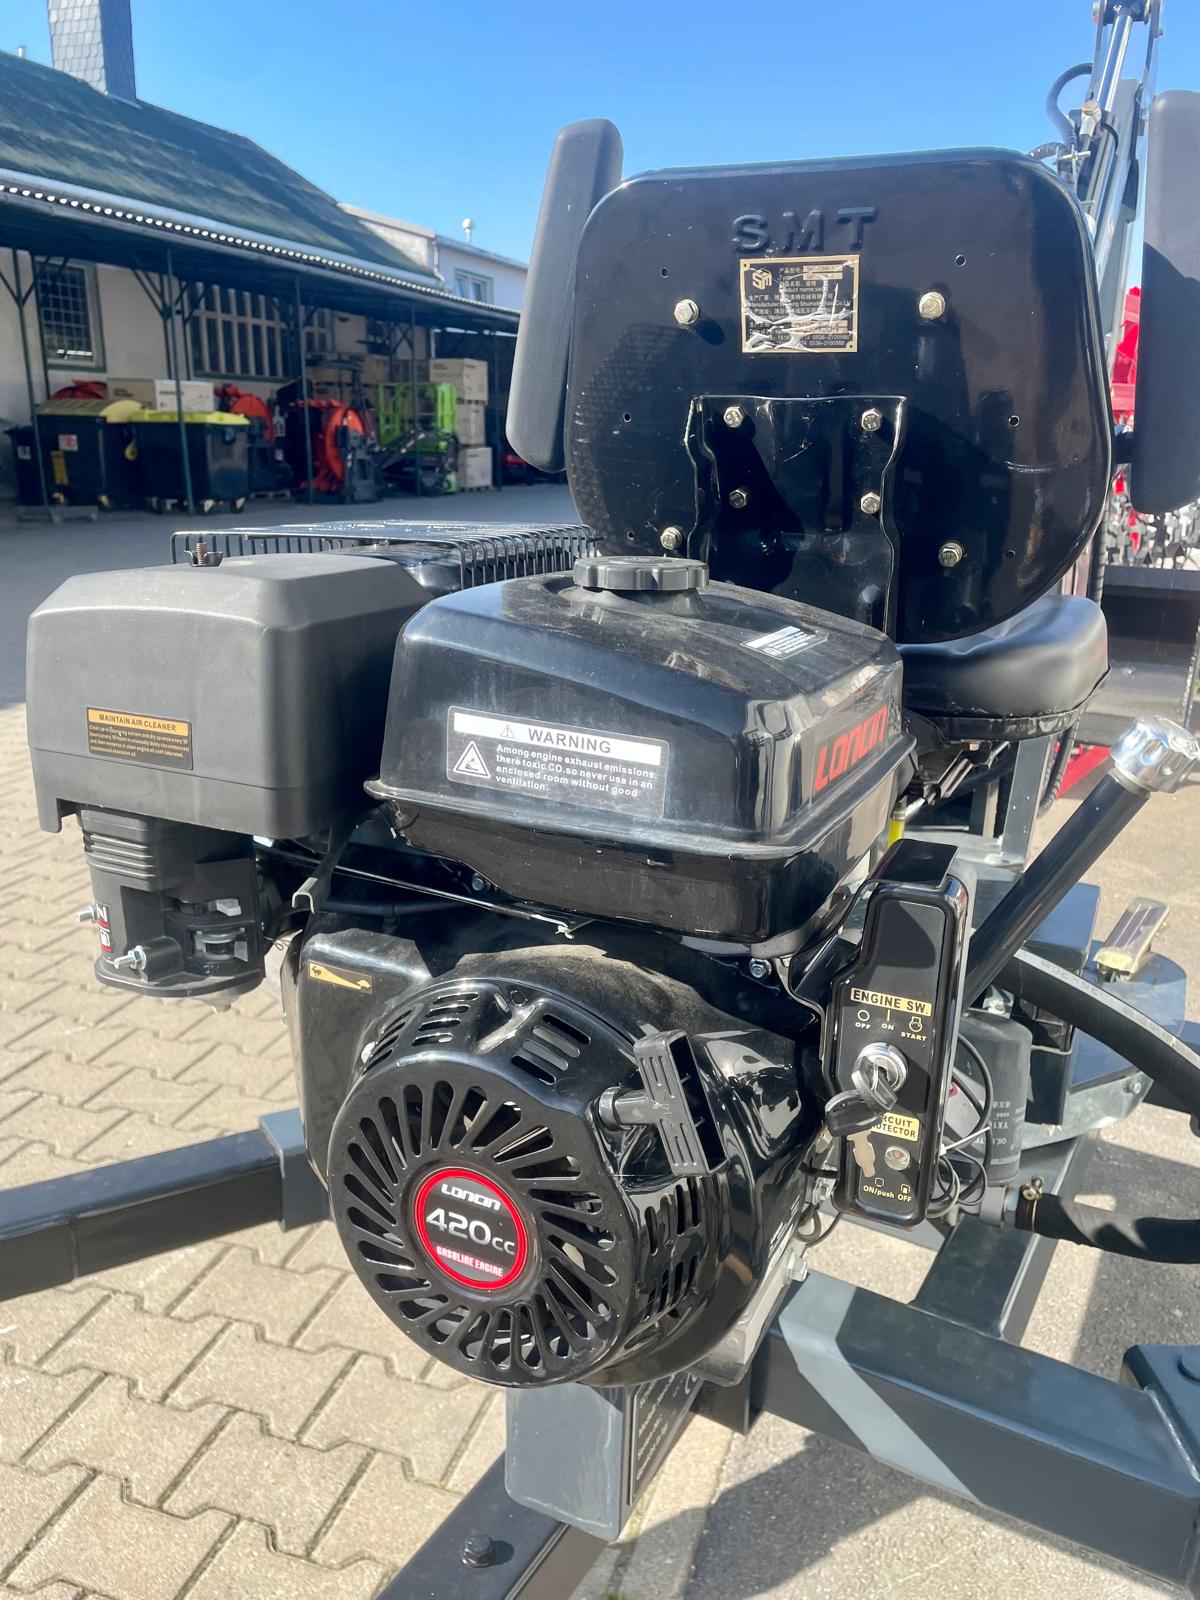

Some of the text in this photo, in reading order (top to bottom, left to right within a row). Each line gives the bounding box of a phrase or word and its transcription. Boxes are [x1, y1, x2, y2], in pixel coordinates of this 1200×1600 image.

[732, 206, 876, 252] SMT
[99, 713, 177, 731] MAINTAIN AIR CLEANER
[528, 728, 611, 754] WARNING
[815, 704, 888, 791] LONCIN
[496, 743, 657, 780] Among engine exhaust emissions.
[496, 754, 520, 766] there
[522, 759, 547, 770] toxic
[580, 769, 608, 781] never
[609, 775, 627, 785] use
[629, 777, 639, 787] in
[640, 781, 653, 789] an
[496, 766, 638, 797] enclosed room without good
[496, 775, 549, 791] ventilation.
[853, 989, 929, 1015] ENGINE SW.
[855, 1021, 872, 1030] OFF
[881, 1023, 895, 1031] ON
[901, 1031, 928, 1042] START
[882, 1115, 912, 1128] RCUIT
[441, 1183, 501, 1211] LONCIN
[863, 1185, 912, 1203] ON/push OFF
[436, 1245, 504, 1278] GASOLINE ENGINE
